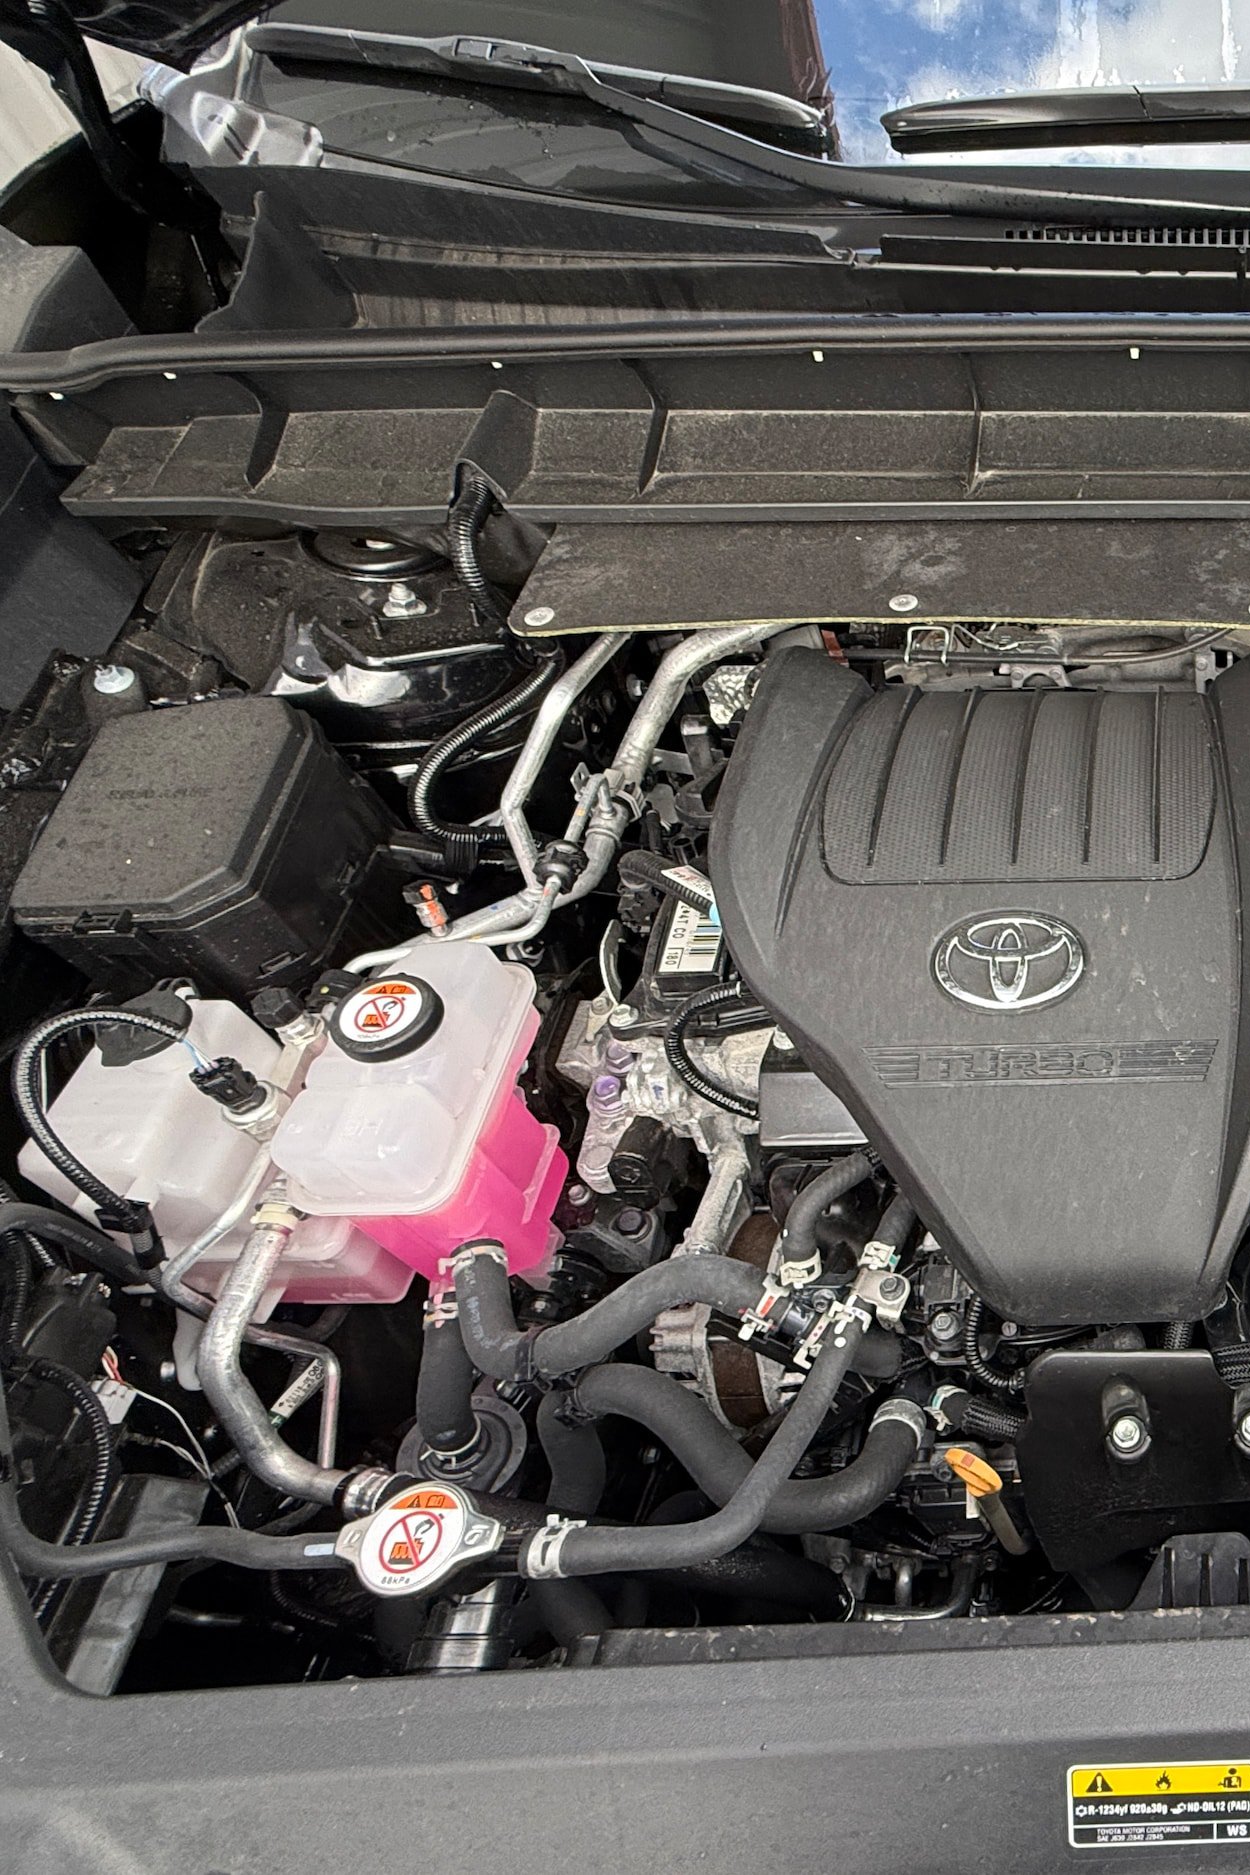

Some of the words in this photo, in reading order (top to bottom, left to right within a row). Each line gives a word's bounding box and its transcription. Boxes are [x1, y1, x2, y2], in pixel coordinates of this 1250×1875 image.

[665, 952, 679, 966] 180
[926, 1050, 1114, 1079] TURBO
[1088, 1803, 1128, 1816] R-1234yf
[1227, 1800, 1250, 1813] (PAG)
[1227, 1824, 1247, 1836] WS
